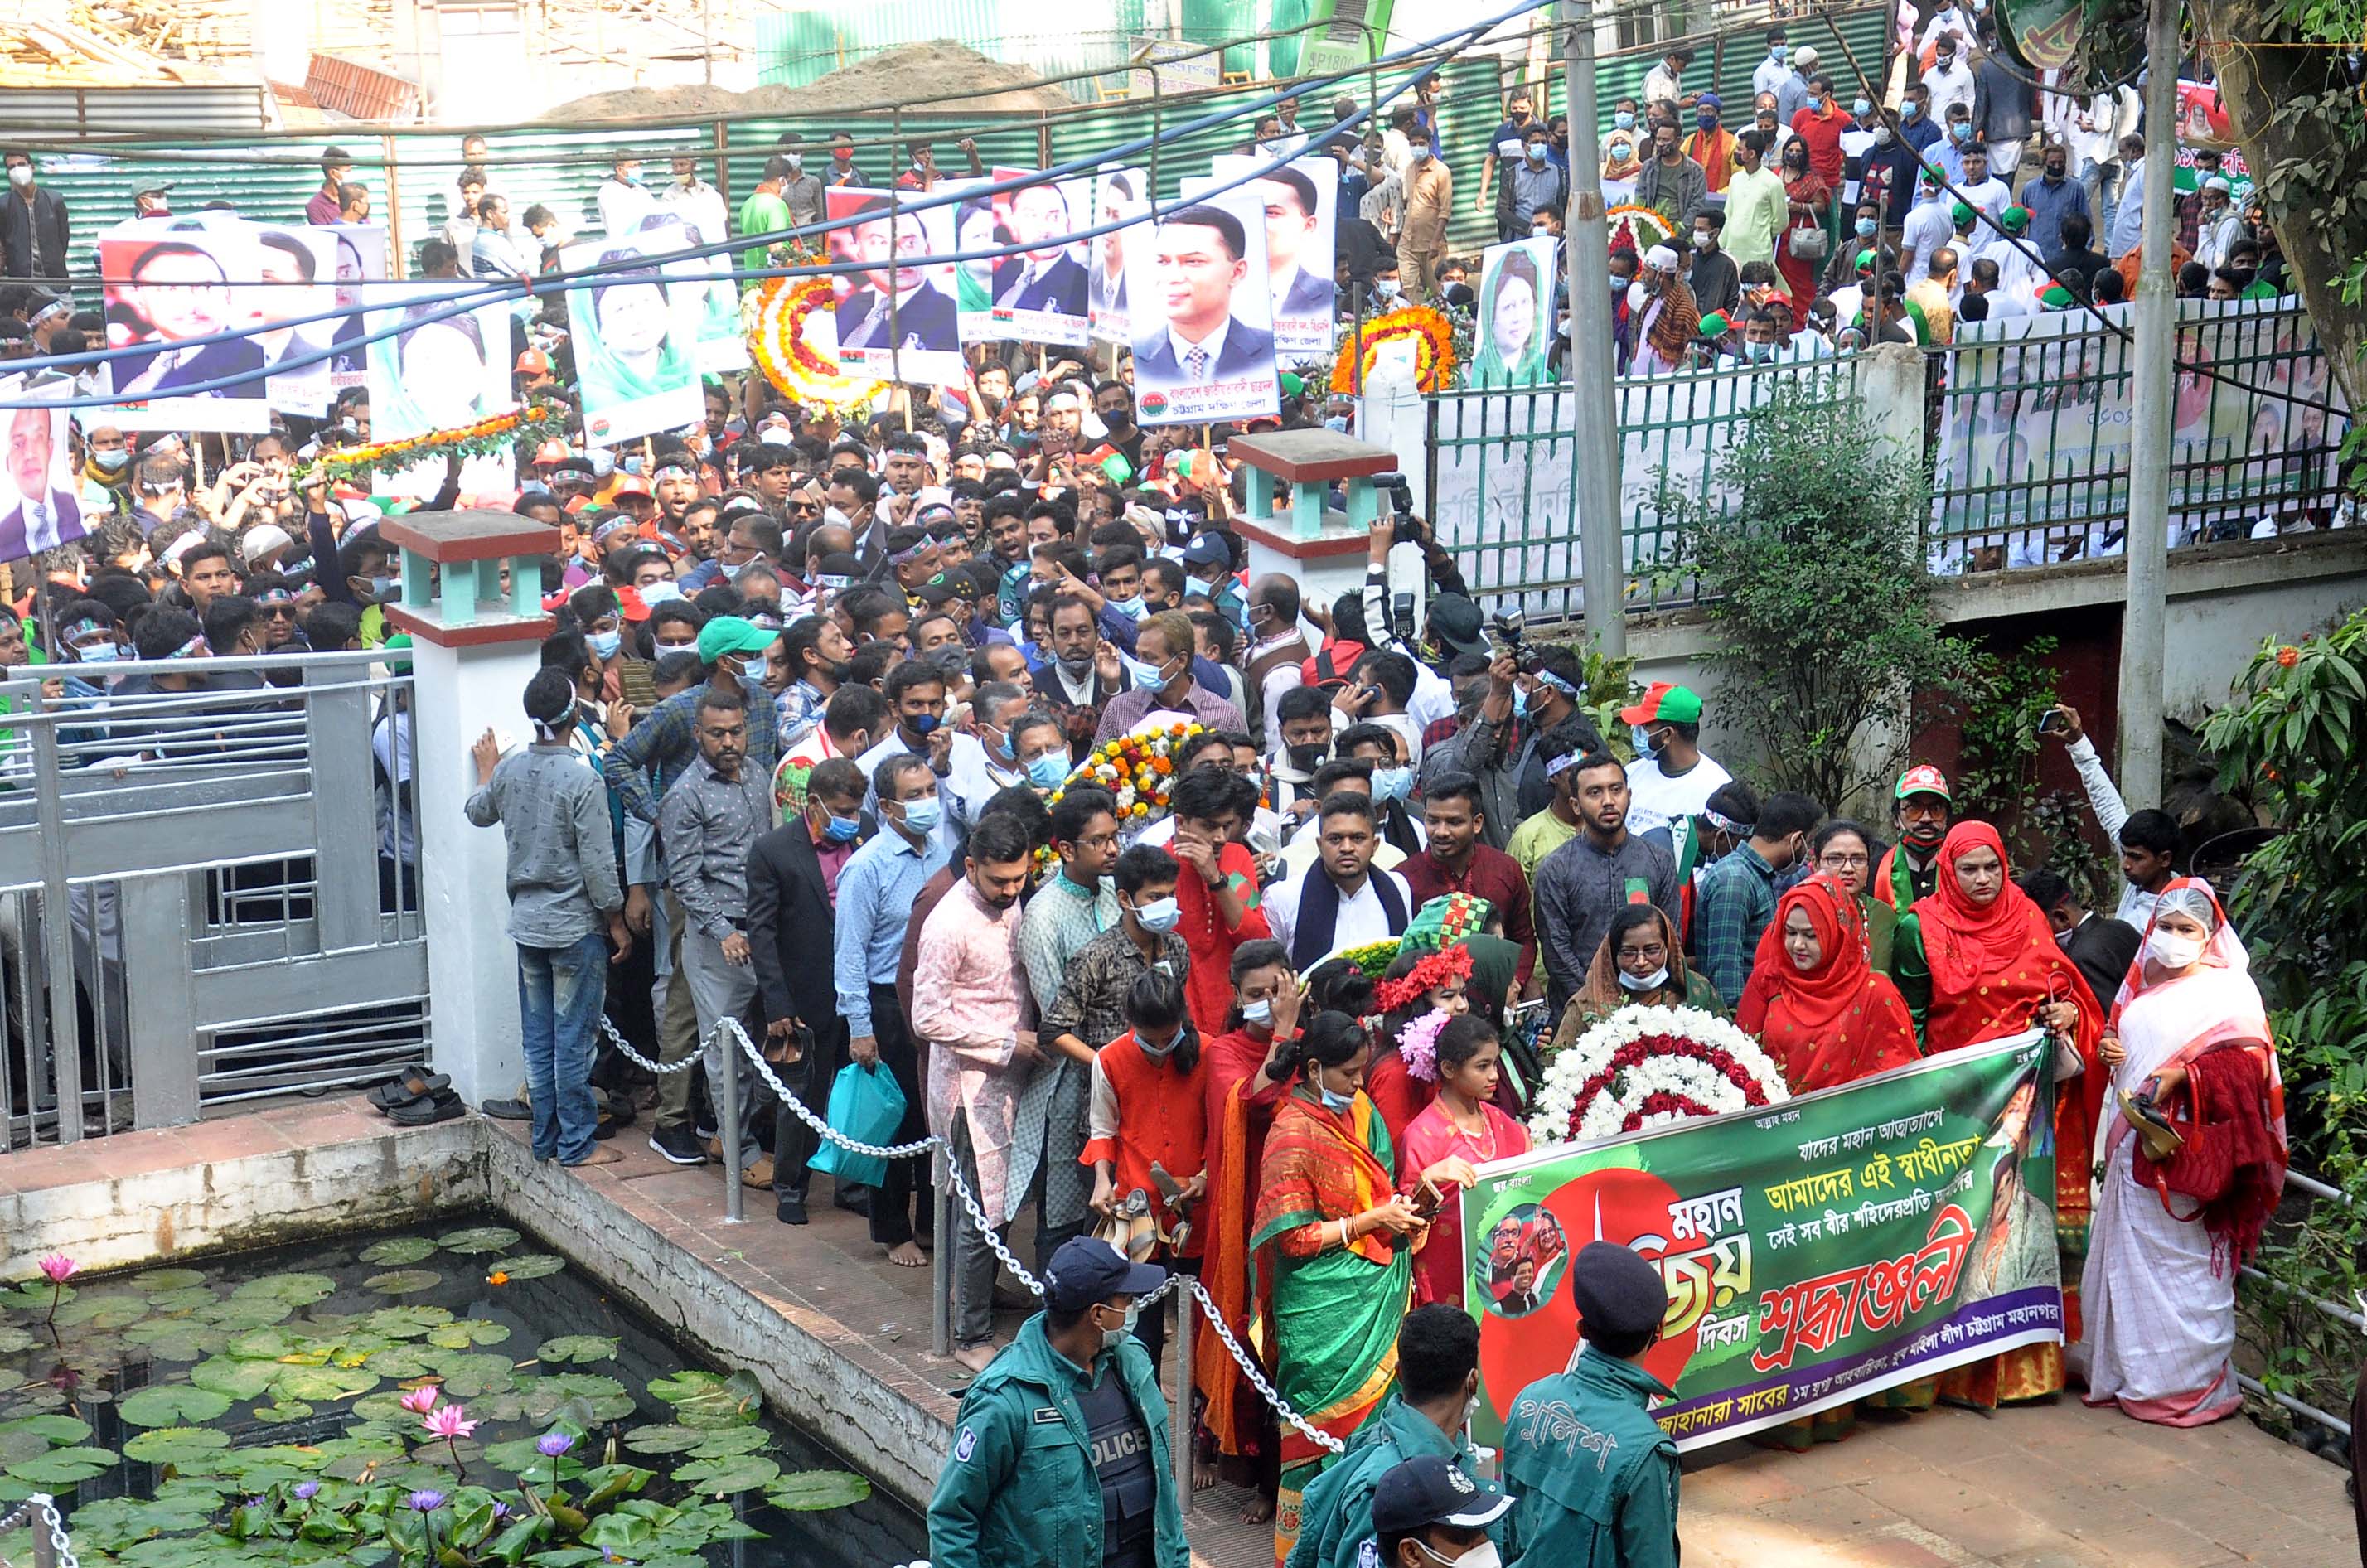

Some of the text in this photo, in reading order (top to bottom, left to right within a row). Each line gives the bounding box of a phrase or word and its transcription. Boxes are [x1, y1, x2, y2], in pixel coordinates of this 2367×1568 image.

[1781, 1110, 1800, 1123] মহান
[1798, 1135, 1838, 1162] যাদের
[1842, 1126, 1873, 1152] মহান
[1764, 1133, 1982, 1213] আমাদের এই স্বাধীনতা
[1668, 1186, 1744, 1241] মহান
[1767, 1220, 1797, 1250] সেই
[1798, 1219, 1822, 1243] সব
[1823, 1208, 1849, 1237] বীর
[1696, 1314, 1750, 1354] দিবস
[1656, 1396, 1734, 1437] জাহানারা
[1737, 1383, 1790, 1416] সাবের
[1909, 1332, 1939, 1355] মহিলা
[1940, 1324, 1964, 1346] লীগ
[1965, 1312, 2005, 1340] চট্টগ্রাম
[2006, 1301, 2060, 1328] মহানগর
[1091, 1427, 1149, 1467] OLICE
[1519, 1399, 1619, 1473] পুলিশ
